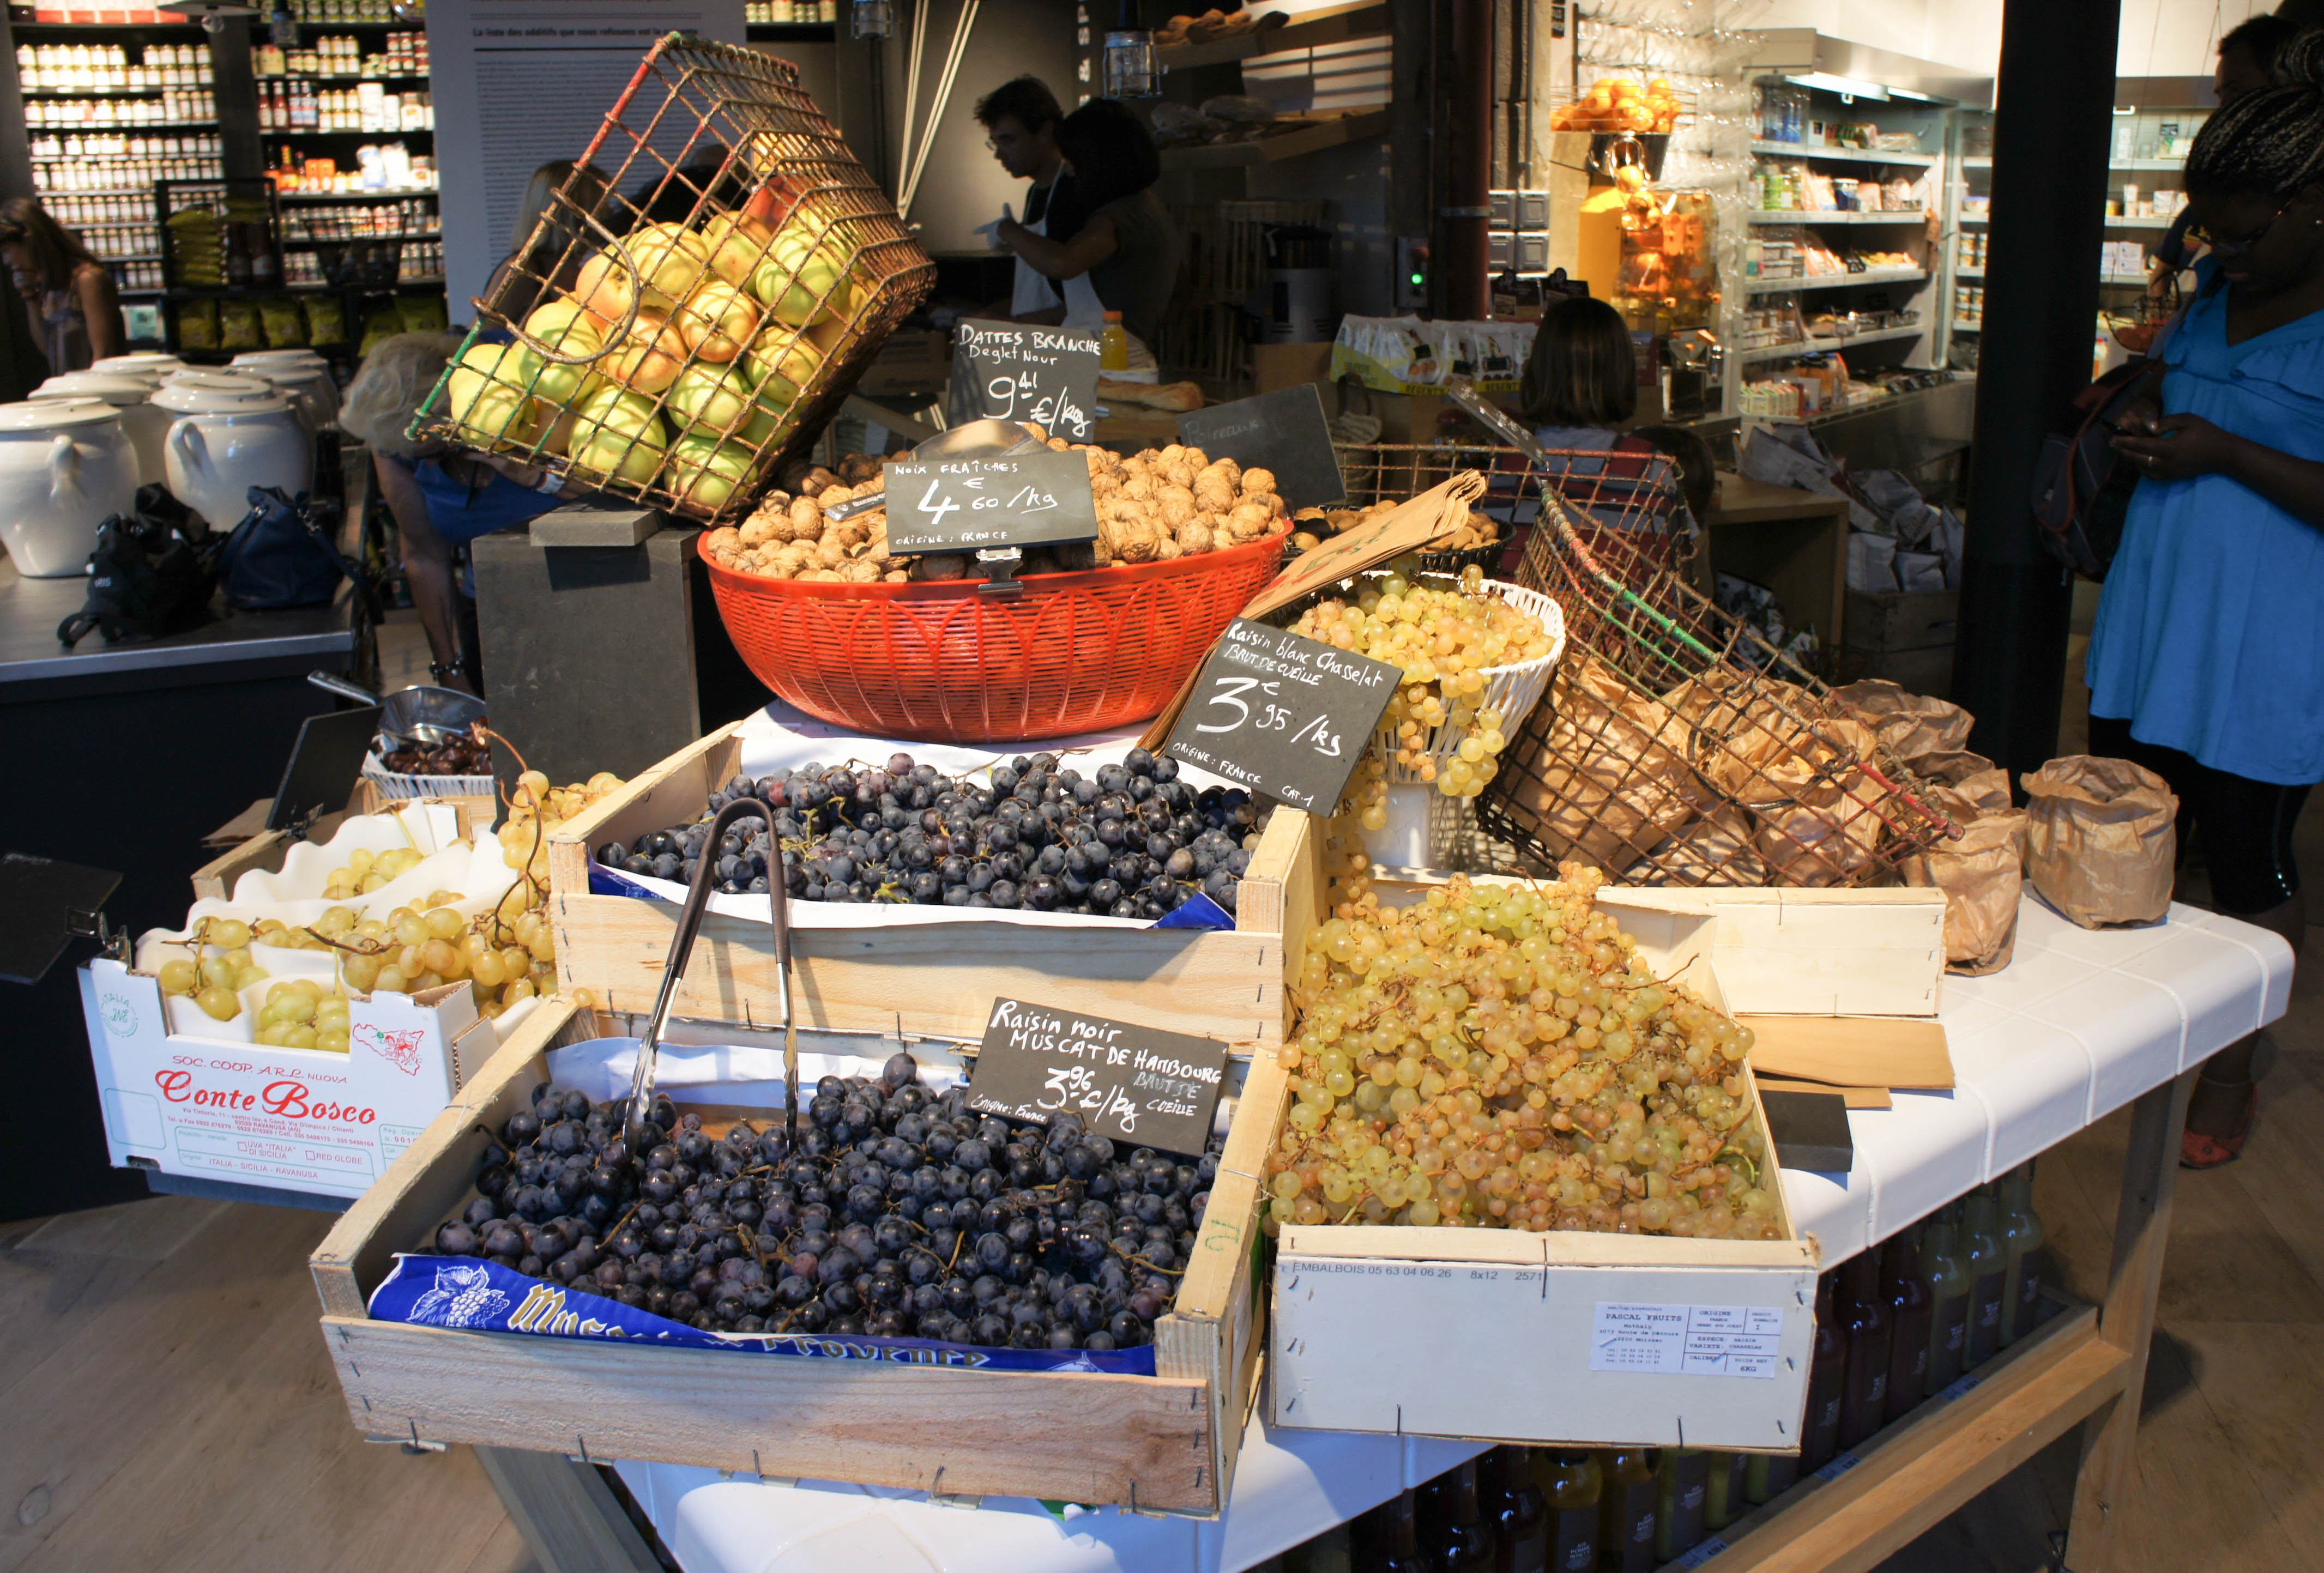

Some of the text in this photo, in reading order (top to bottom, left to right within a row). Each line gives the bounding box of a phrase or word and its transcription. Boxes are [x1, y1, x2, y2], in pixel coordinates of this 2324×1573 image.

[959, 324, 1101, 355] DATTES BRANCHE
[1023, 350, 1058, 365] Nour
[961, 532, 1007, 541] FRANCE
[1224, 644, 1259, 664] BRUT
[1254, 657, 1277, 671] DE
[1227, 621, 1384, 687] Raisin blanc Chasselat
[1219, 760, 1262, 784] FRANCE
[990, 1000, 1123, 1043] Raisin noir
[1010, 1029, 1222, 1084] MUSCAT DE HAMBOURG
[307, 1073, 348, 1084] NUOVA
[155, 1070, 376, 1125] Conte Bosco
[209, 1159, 233, 1167] ITALIA
[276, 1167, 318, 1178] RAVANUSA
[316, 1153, 362, 1165] RED GLOBE
[1293, 1262, 1365, 1274] EMBALBOIS
[1368, 1264, 1383, 1275] 05
[1386, 1265, 1400, 1276] 63
[1403, 1266, 1417, 1277] 04
[1420, 1267, 1434, 1278] 06
[1438, 1268, 1452, 1279] 26
